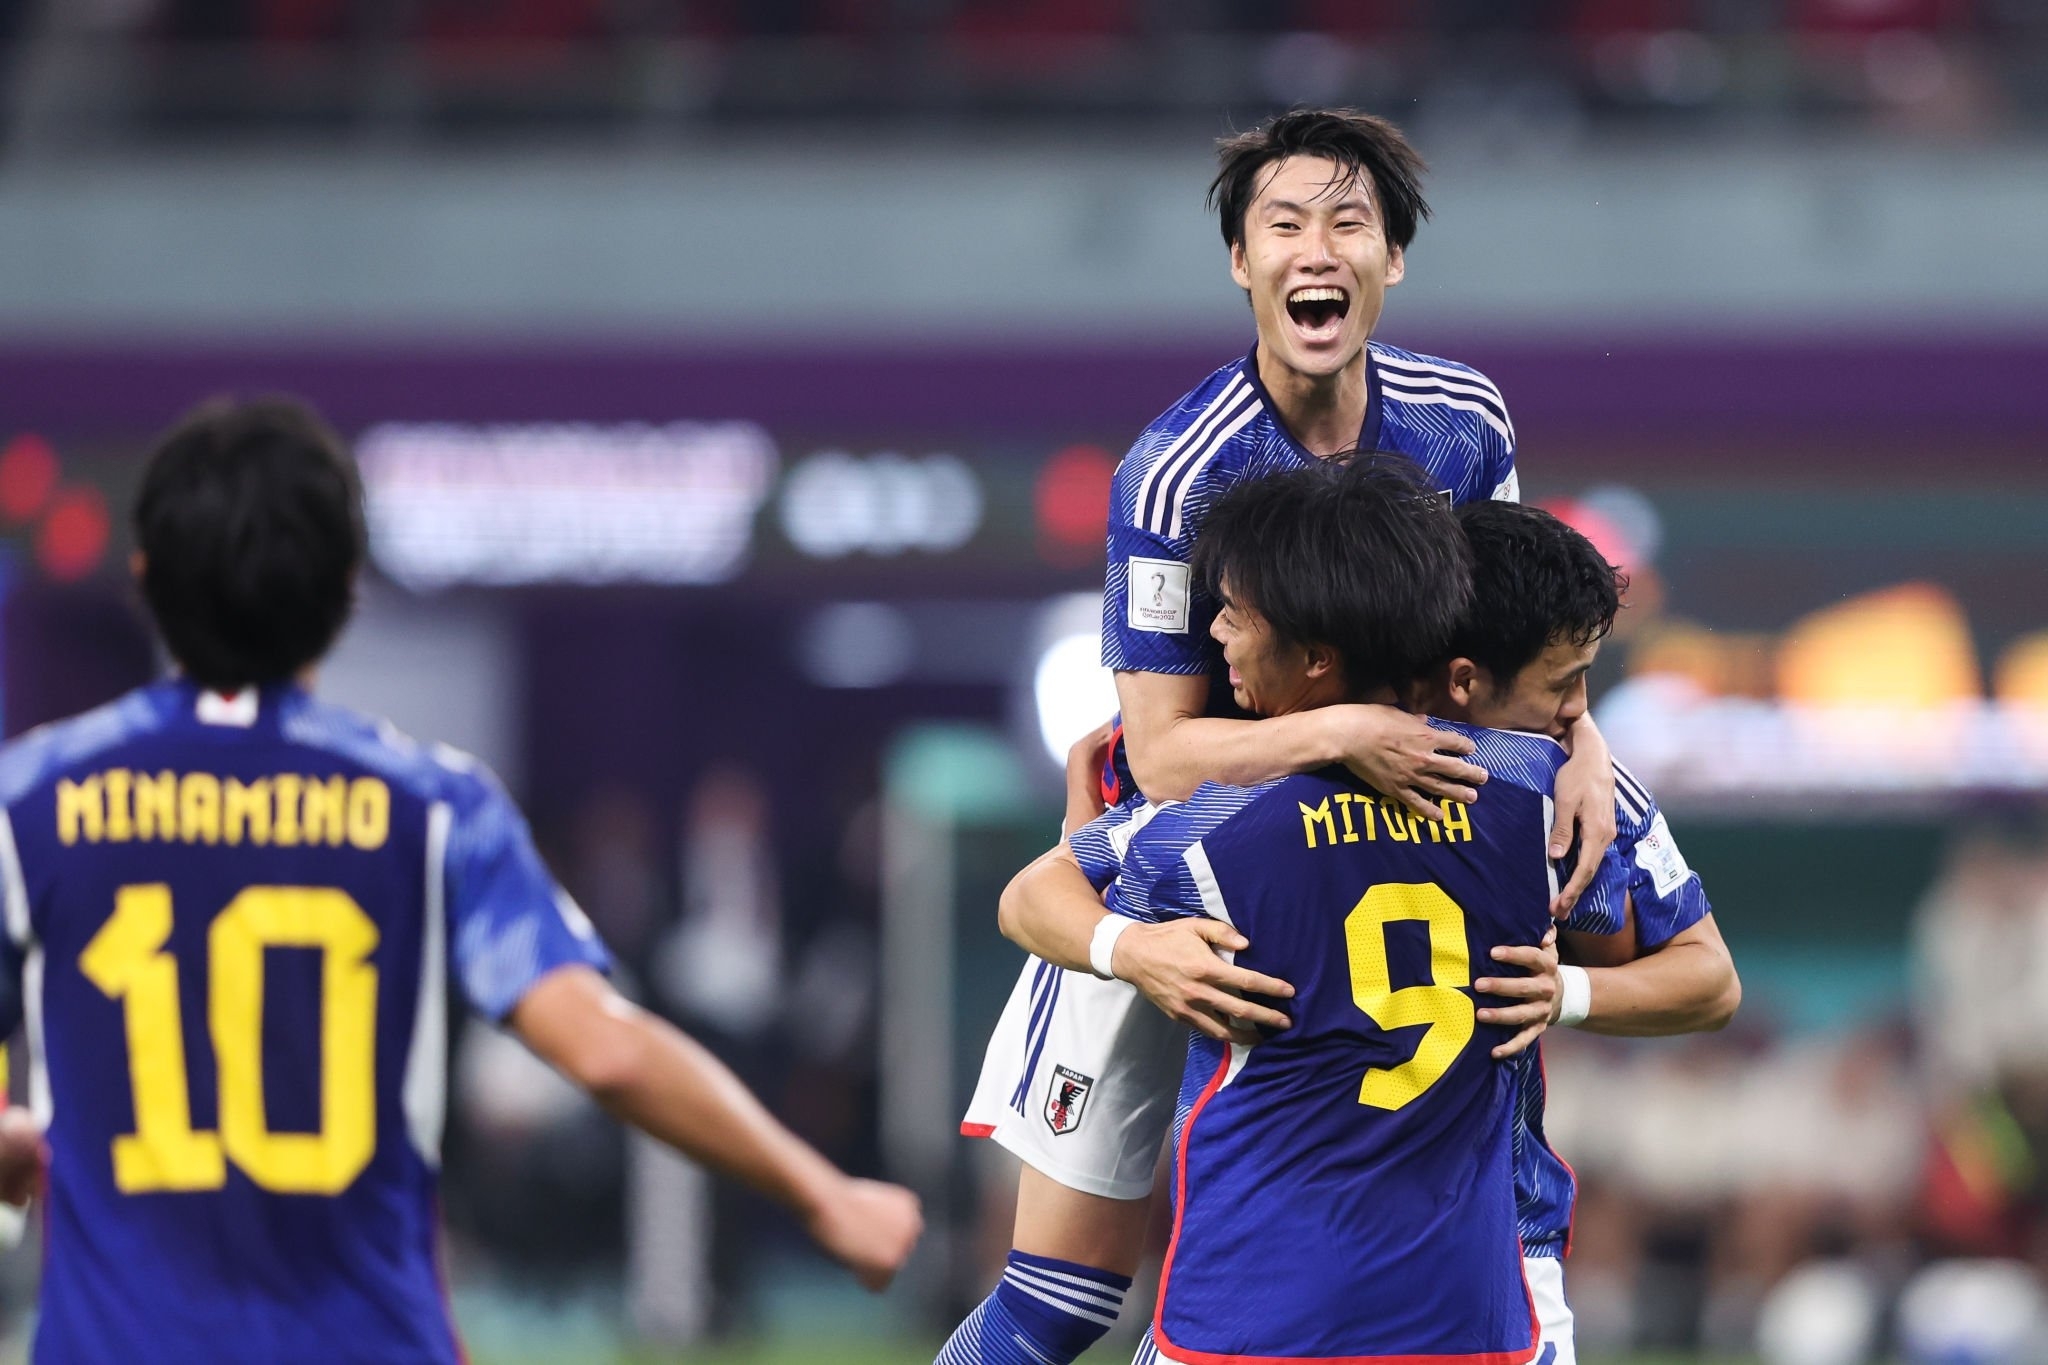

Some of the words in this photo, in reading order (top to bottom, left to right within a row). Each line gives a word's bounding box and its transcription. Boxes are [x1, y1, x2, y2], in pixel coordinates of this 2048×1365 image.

[57, 769, 391, 850] MINAMINO
[78, 882, 380, 1195] 10
[1344, 882, 1475, 1111] 9
[1061, 1068, 1084, 1082] JAPAN
